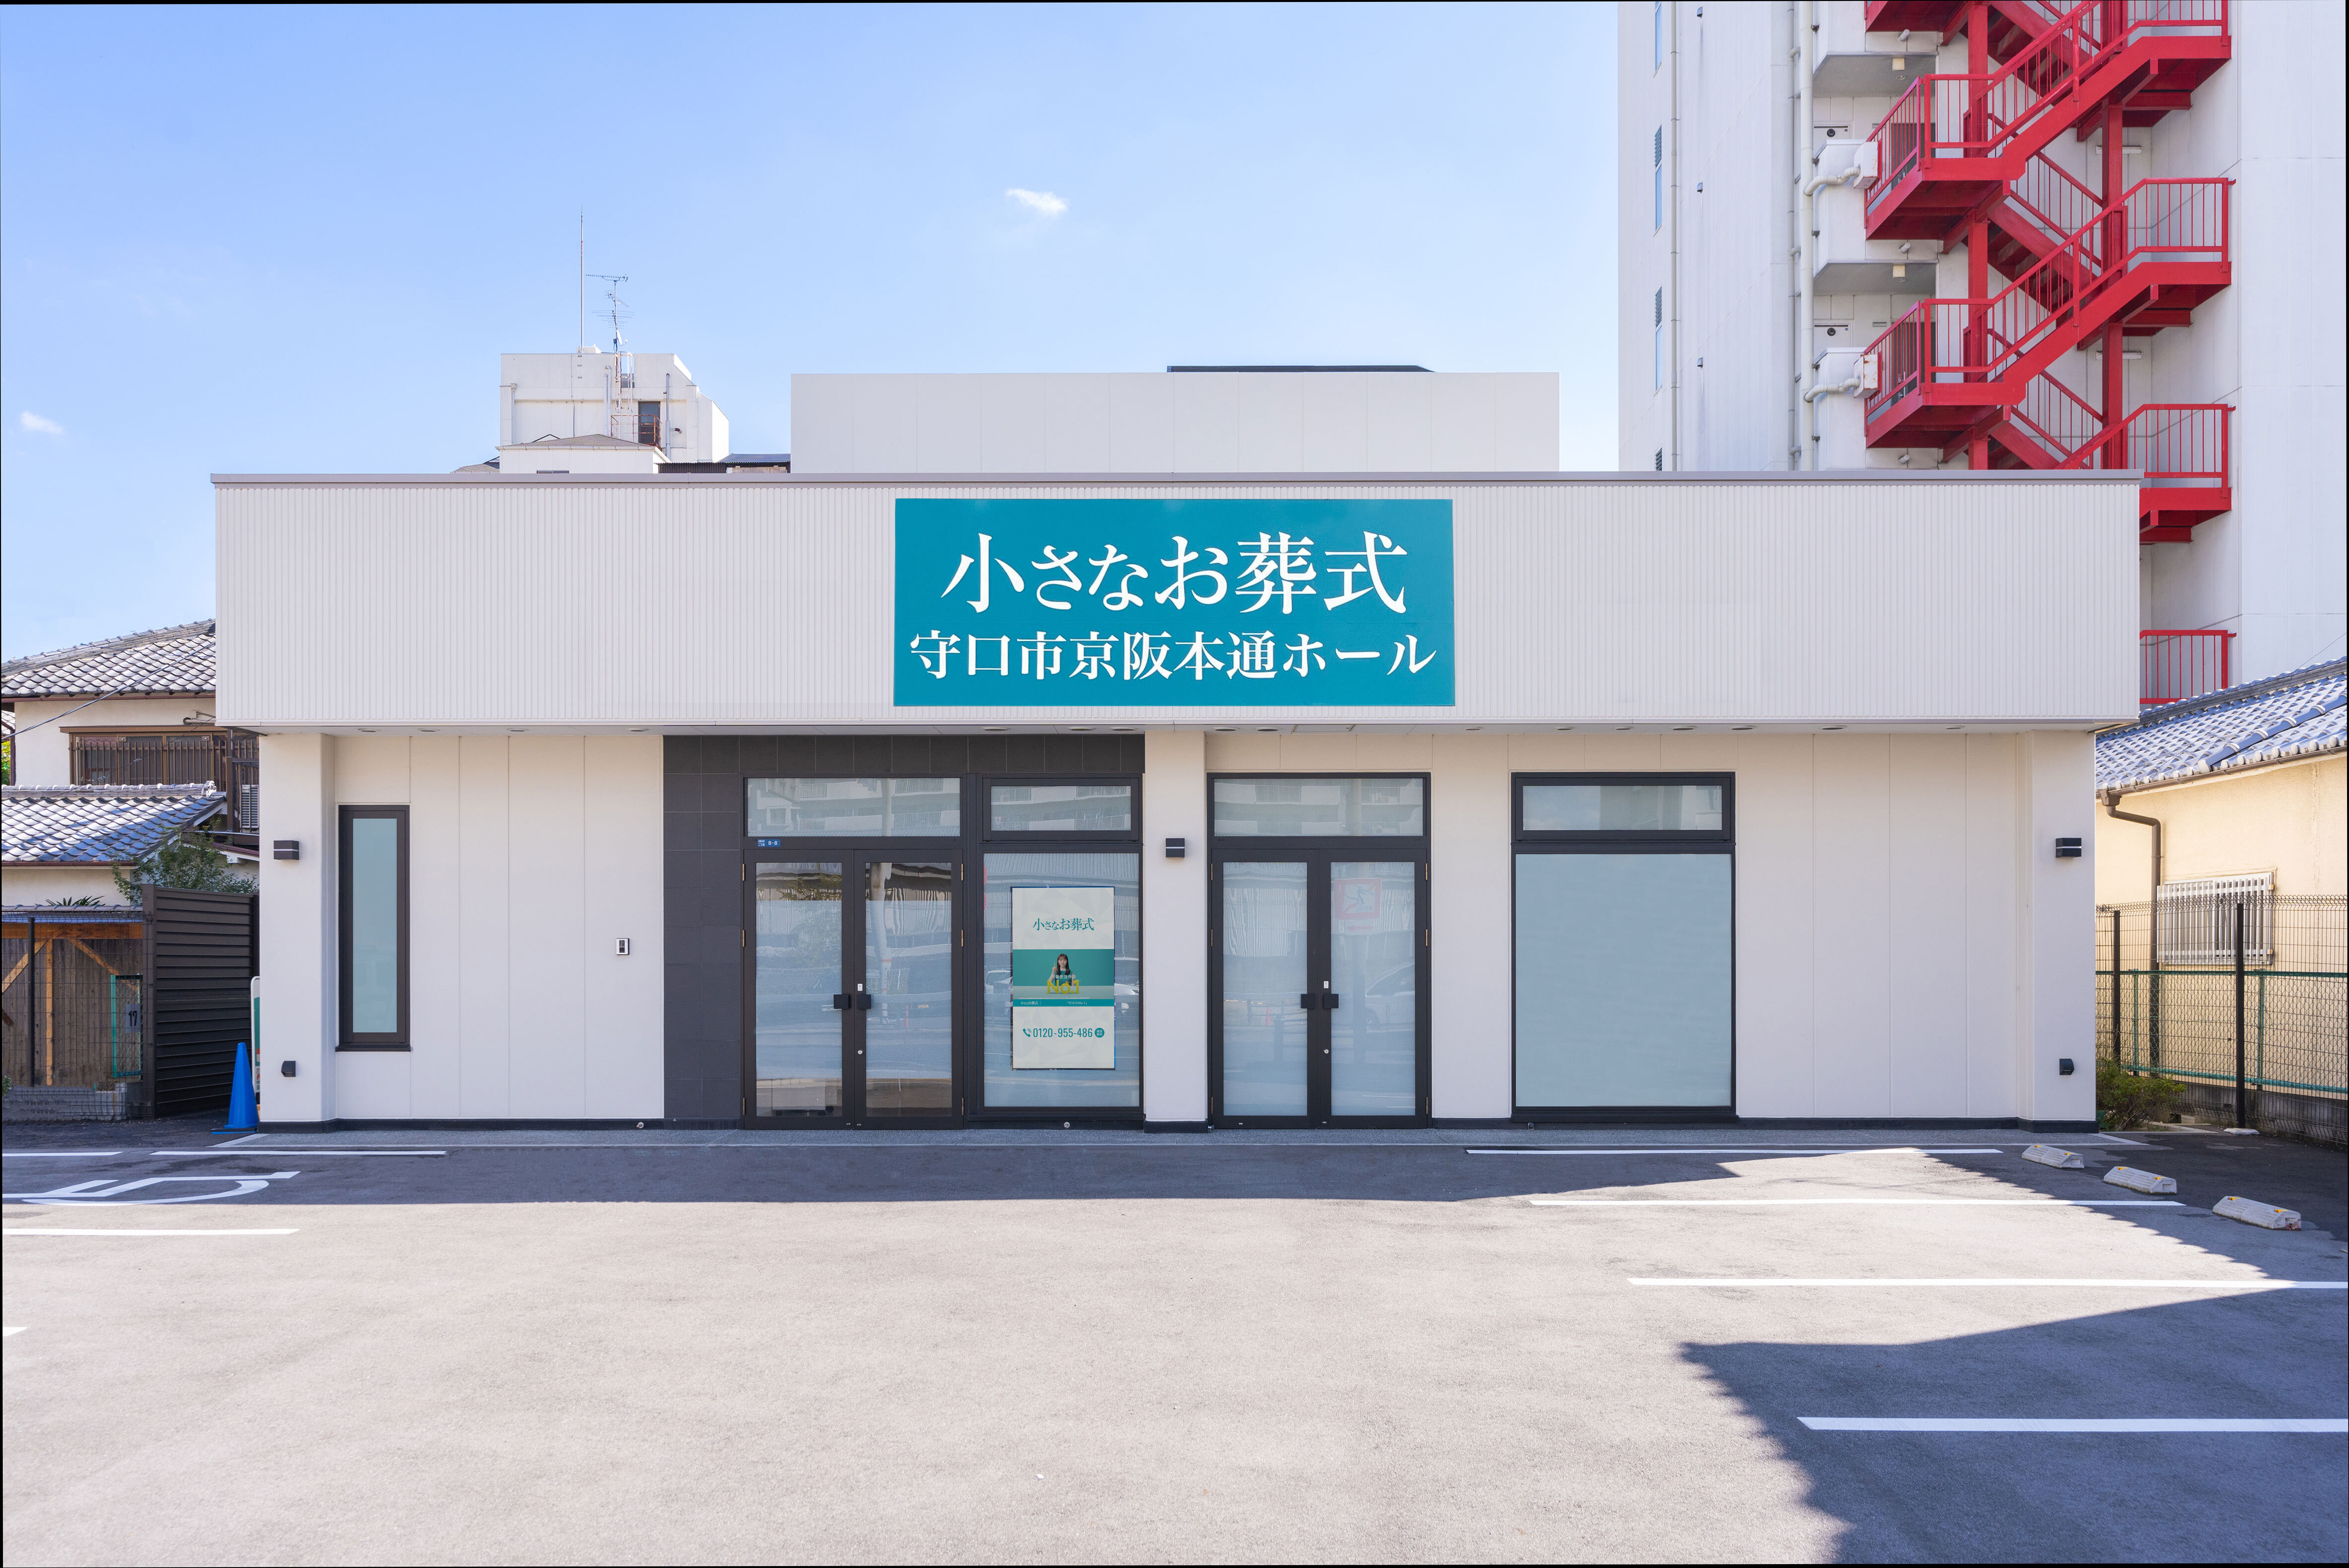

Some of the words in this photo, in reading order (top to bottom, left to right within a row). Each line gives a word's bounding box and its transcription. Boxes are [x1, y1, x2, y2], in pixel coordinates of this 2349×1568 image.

[940, 531, 1407, 614] 小さなお葬式
[910, 629, 1436, 681] 守口市京阪本通ホール
[1033, 918, 1094, 931] 小さなお葬式
[1047, 979, 1079, 994] No.1
[129, 1011, 138, 1026] 17
[1033, 1028, 1093, 1037] 0120-955-486
